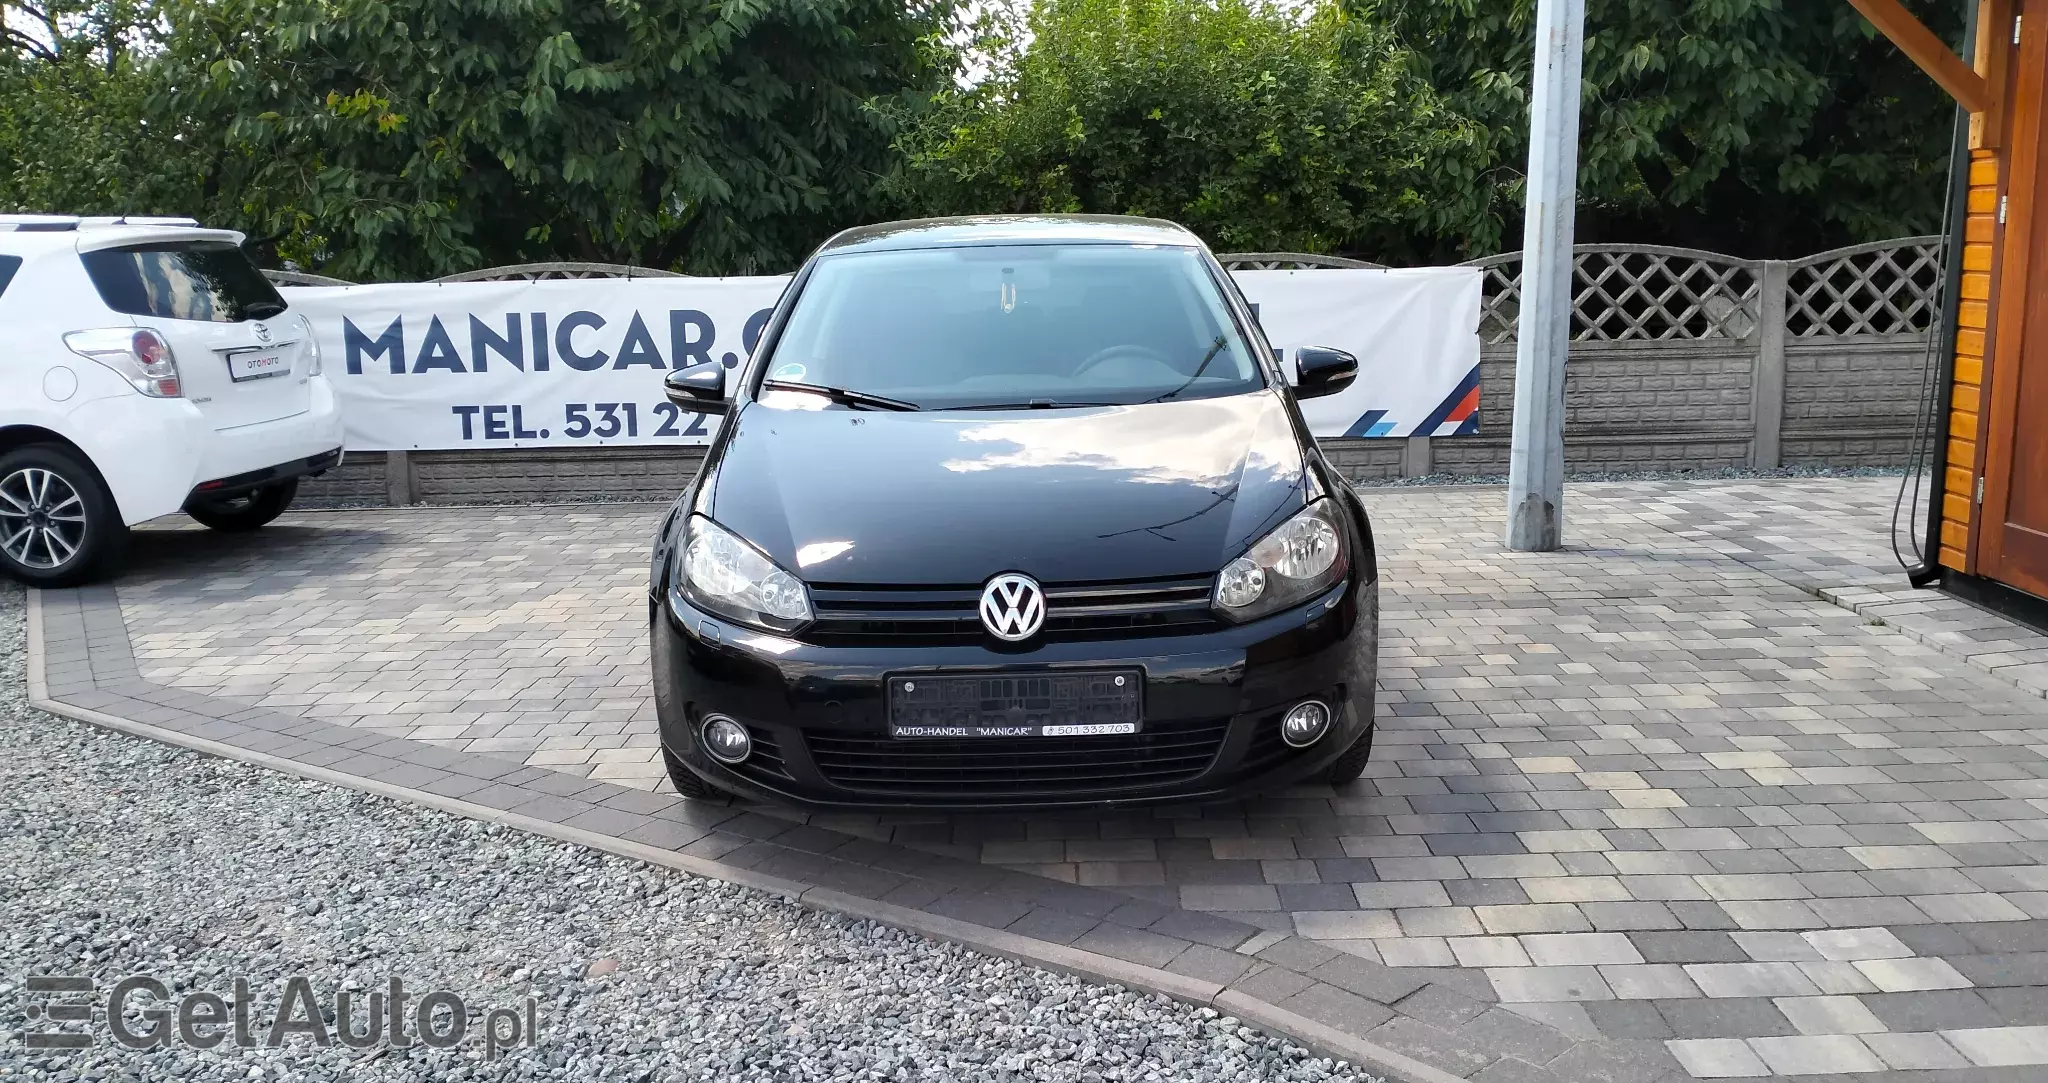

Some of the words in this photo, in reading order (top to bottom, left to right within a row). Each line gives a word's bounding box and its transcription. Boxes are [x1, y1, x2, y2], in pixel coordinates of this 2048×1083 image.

[247, 357, 279, 369] OTOMOTO
[452, 404, 550, 440] TEL.
[564, 402, 638, 438] 531
[896, 727, 969, 736] AUTO-HANDEL
[1058, 726, 1079, 735] 501
[1082, 725, 1105, 734] 332
[1108, 724, 1130, 733] 703
